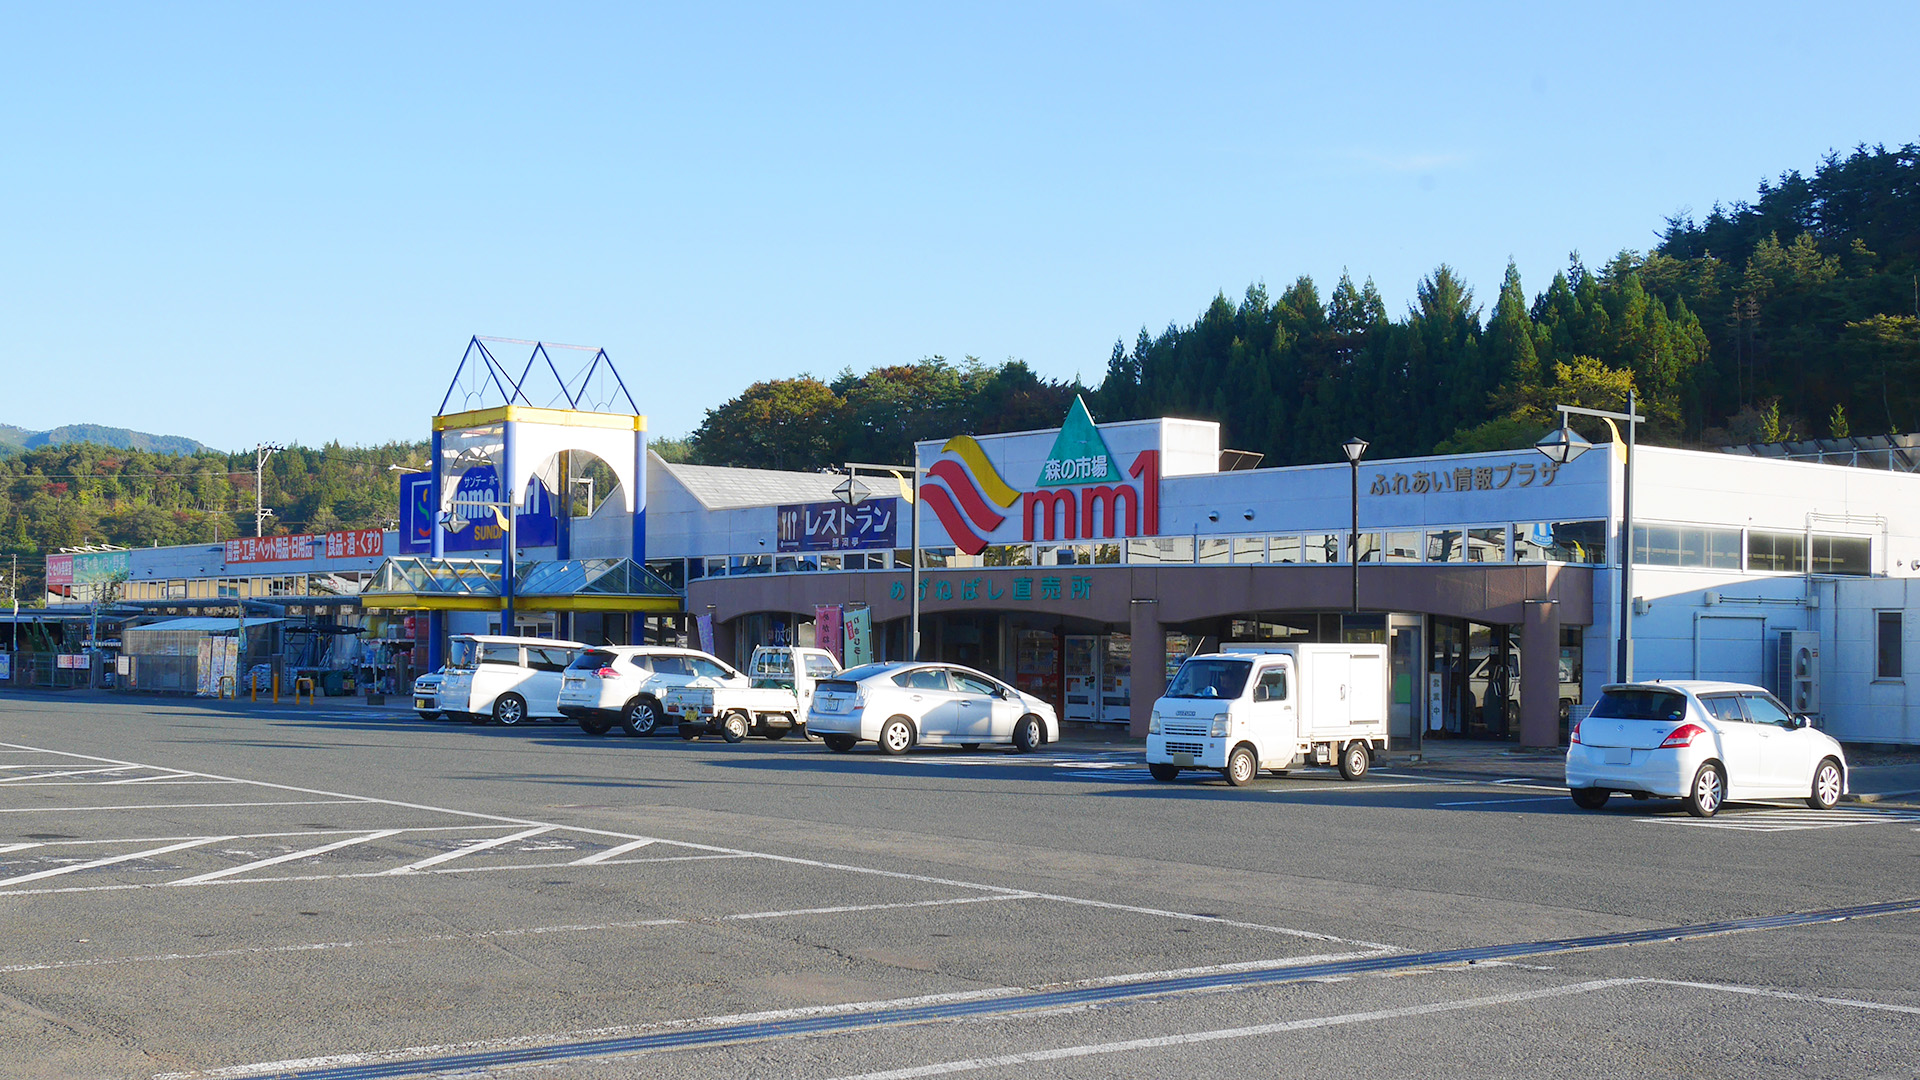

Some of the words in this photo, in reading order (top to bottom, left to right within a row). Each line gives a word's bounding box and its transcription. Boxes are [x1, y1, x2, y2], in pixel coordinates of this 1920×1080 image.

[464, 474, 487, 488] サンデー
[1045, 455, 1108, 481] 森の市場
[1370, 462, 1560, 496] ふれあい情報プラザ
[1023, 449, 1159, 541] mm1
[805, 504, 891, 535] レストラン
[327, 530, 381, 556] 食品・酒・くすり
[890, 575, 1093, 601] めがねばし直売所
